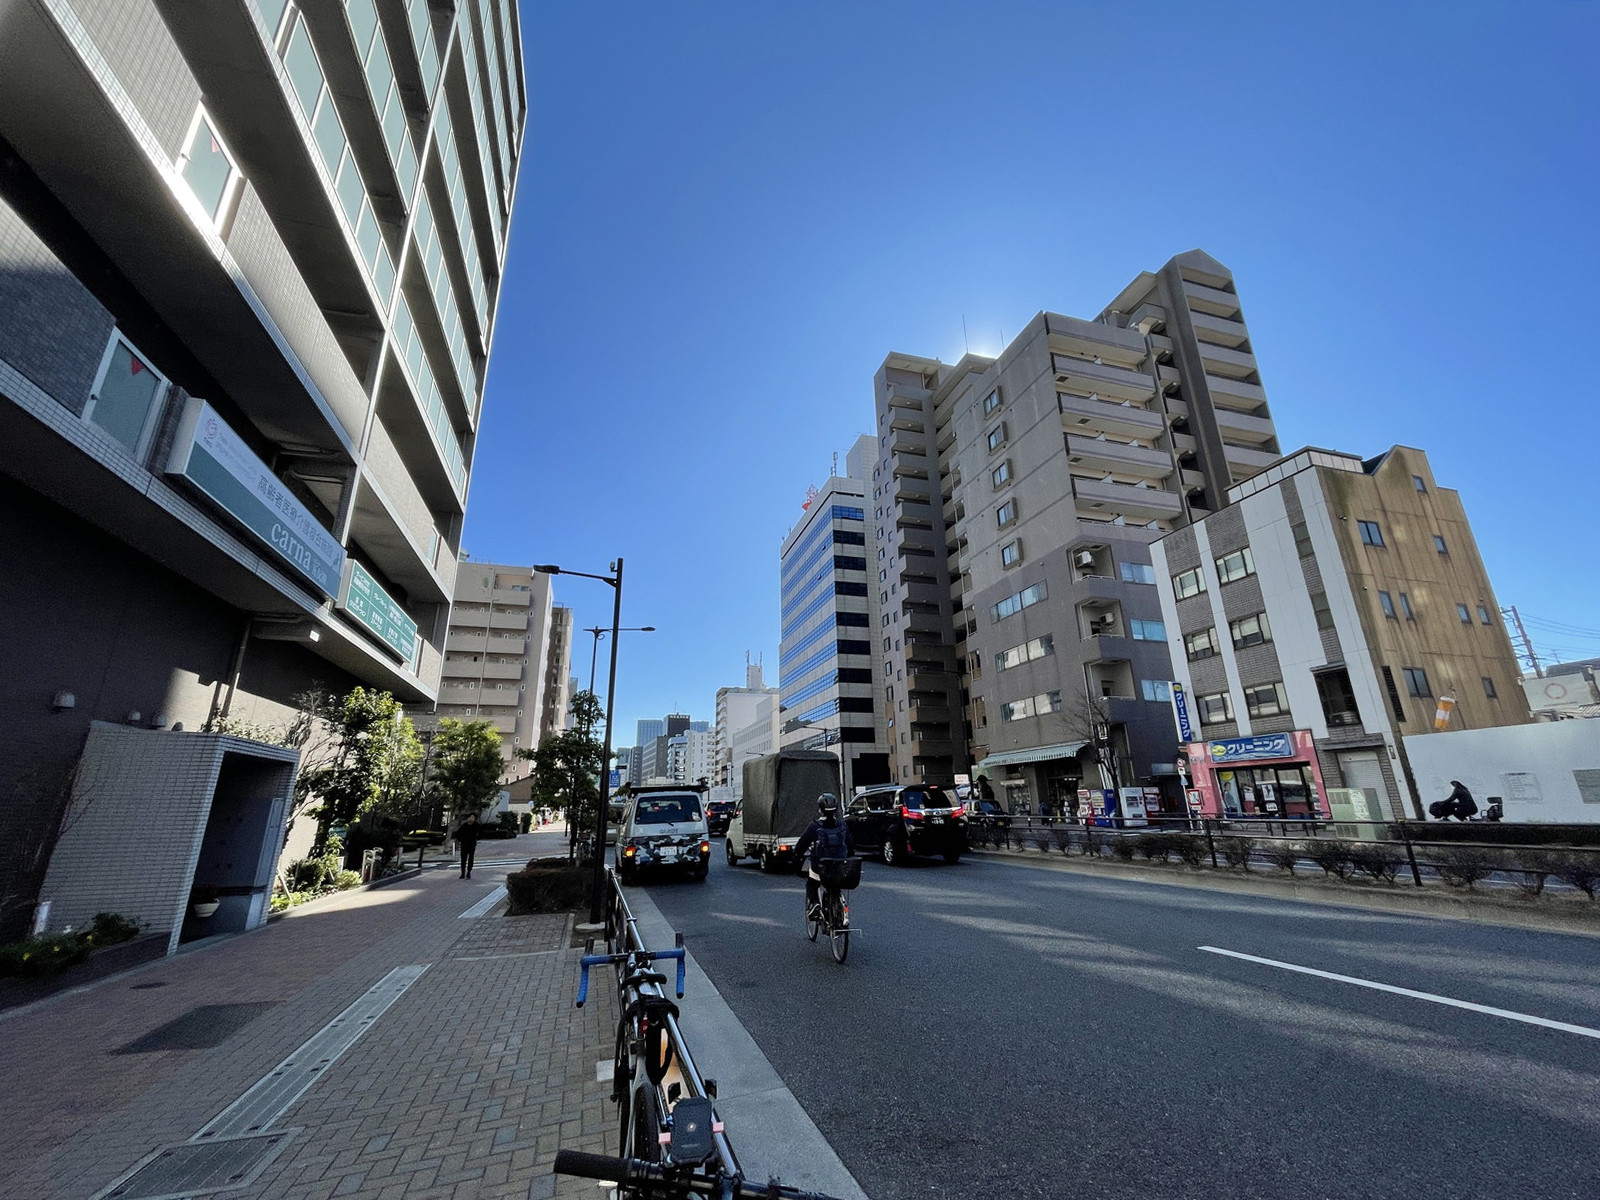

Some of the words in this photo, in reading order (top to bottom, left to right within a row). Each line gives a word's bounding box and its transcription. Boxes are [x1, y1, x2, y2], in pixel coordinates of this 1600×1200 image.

[271, 523, 312, 571] carna
[1175, 692, 1191, 737] クリーニング
[1227, 739, 1285, 754] クリーニング
